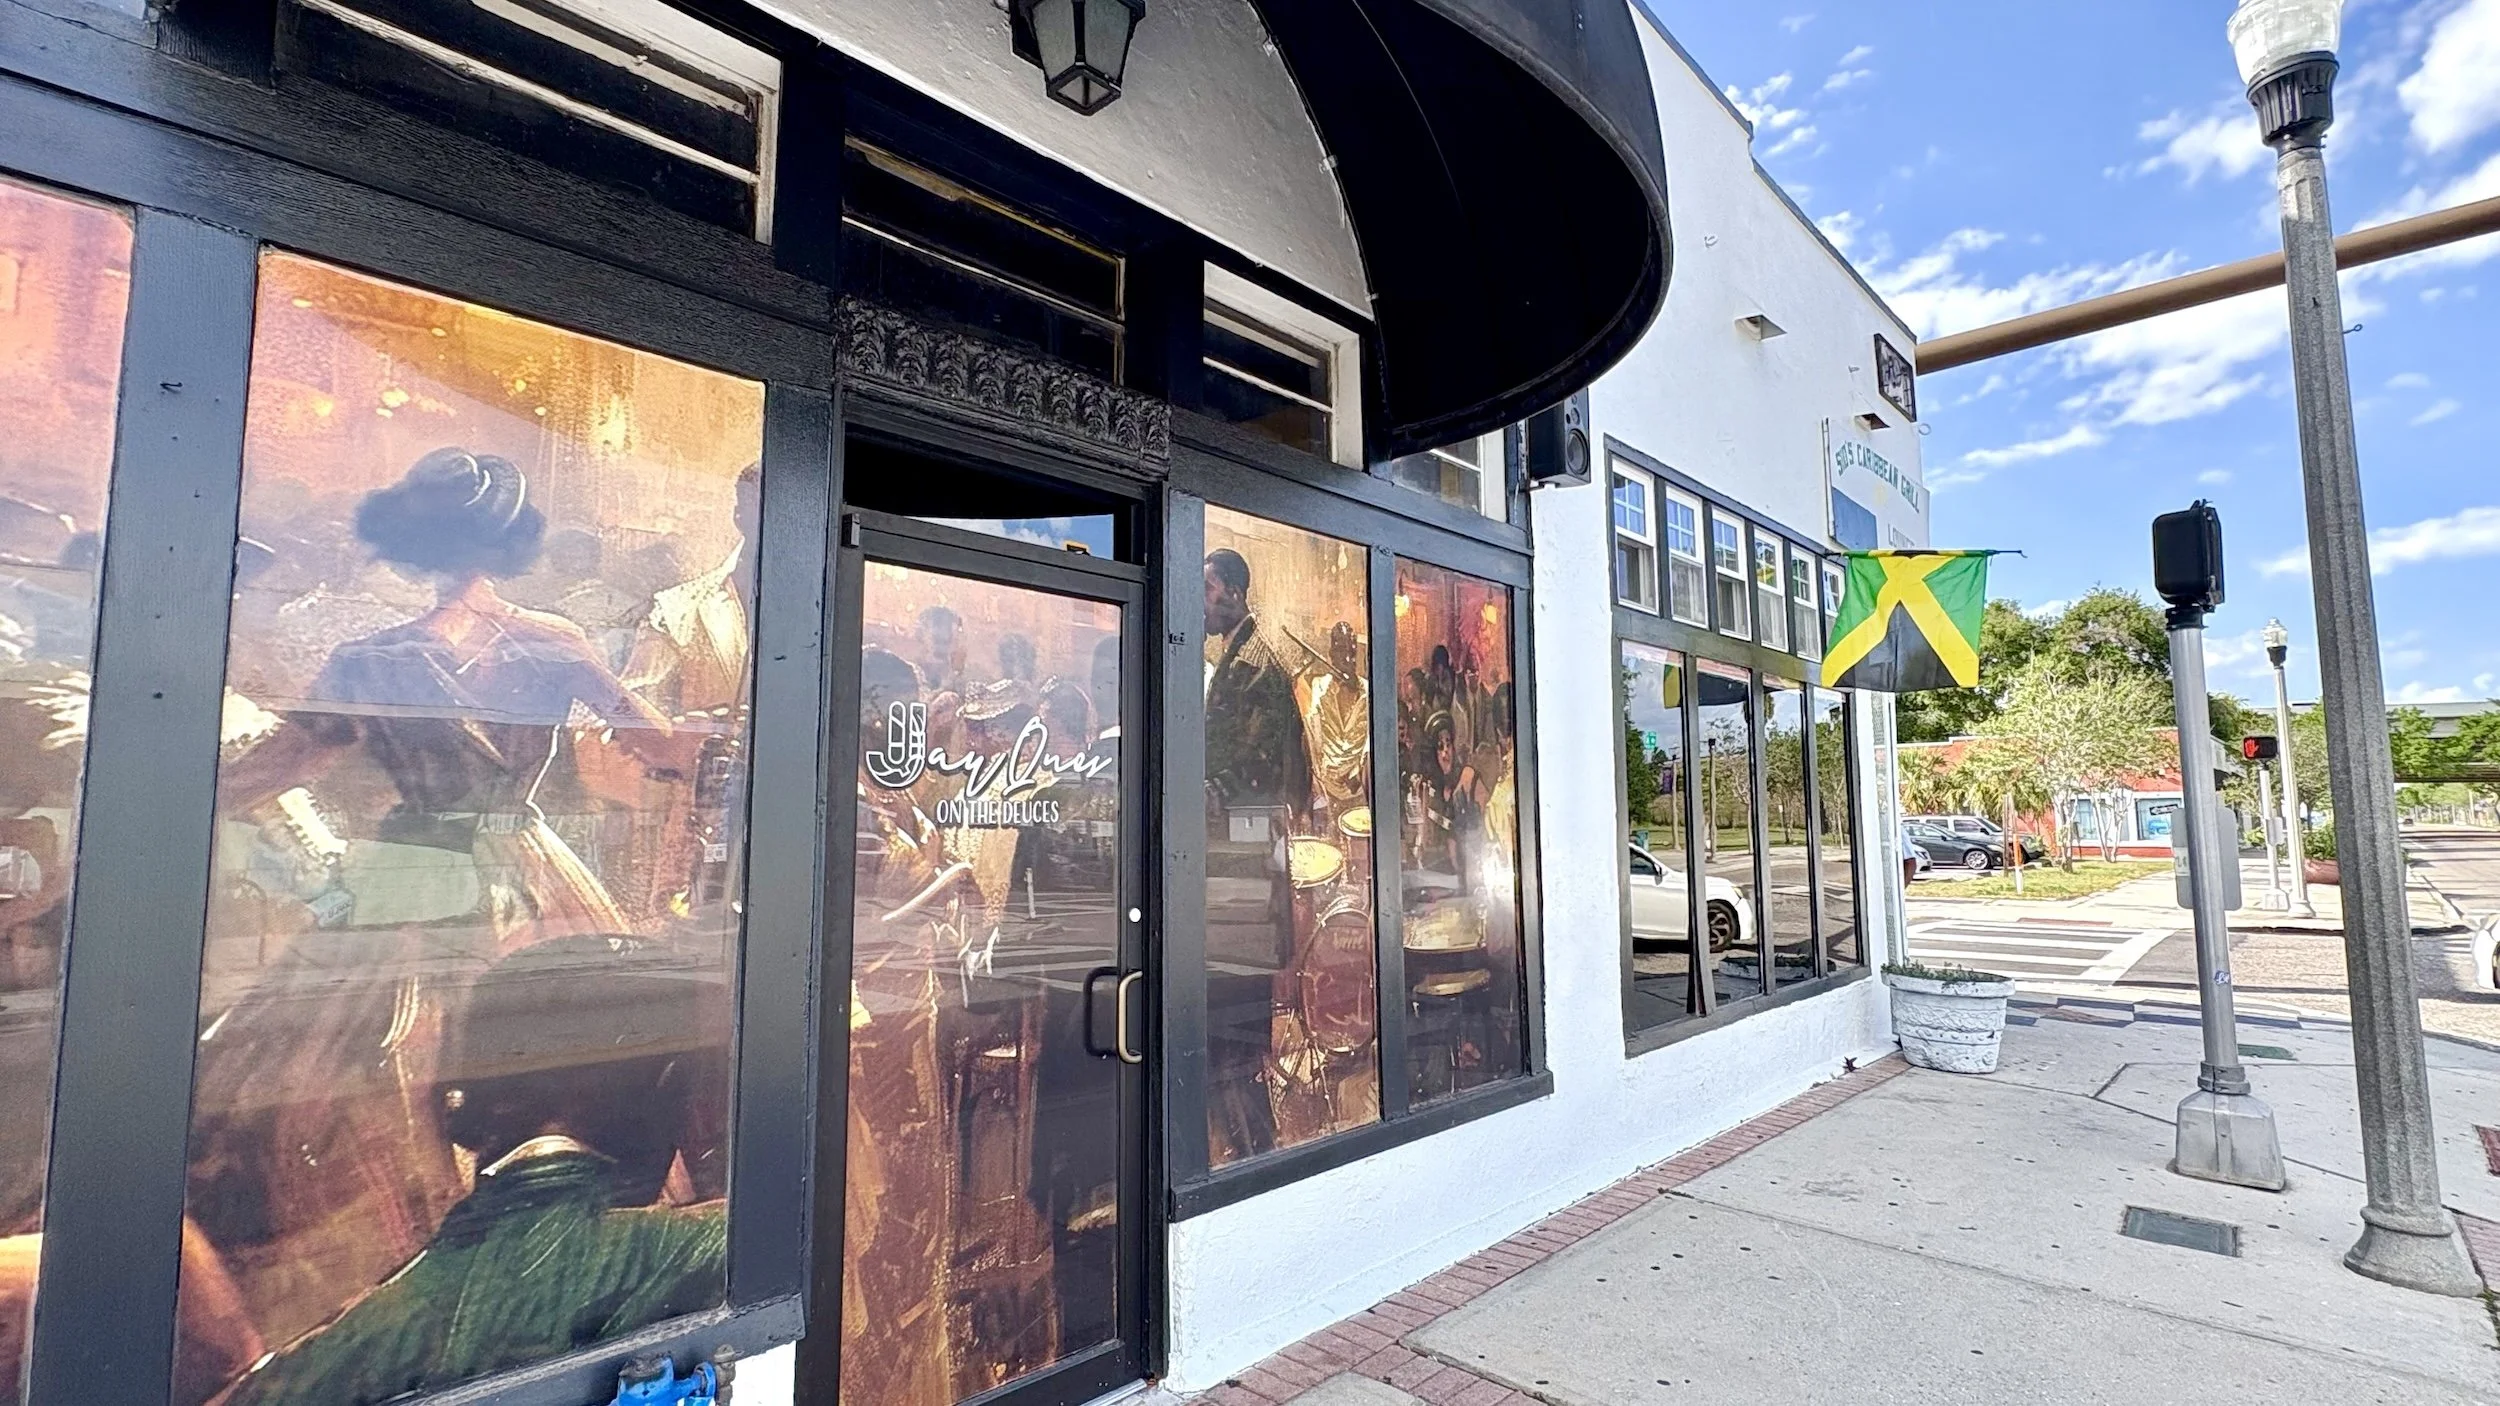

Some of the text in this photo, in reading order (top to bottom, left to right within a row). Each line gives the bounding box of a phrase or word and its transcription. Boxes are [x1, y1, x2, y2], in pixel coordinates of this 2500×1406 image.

[1857, 443, 1899, 490] CARIBBEAN
[1901, 475, 1920, 514] GRILL
[866, 700, 1007, 798] Jay
[936, 799, 1060, 824] ON THE DEUCES
